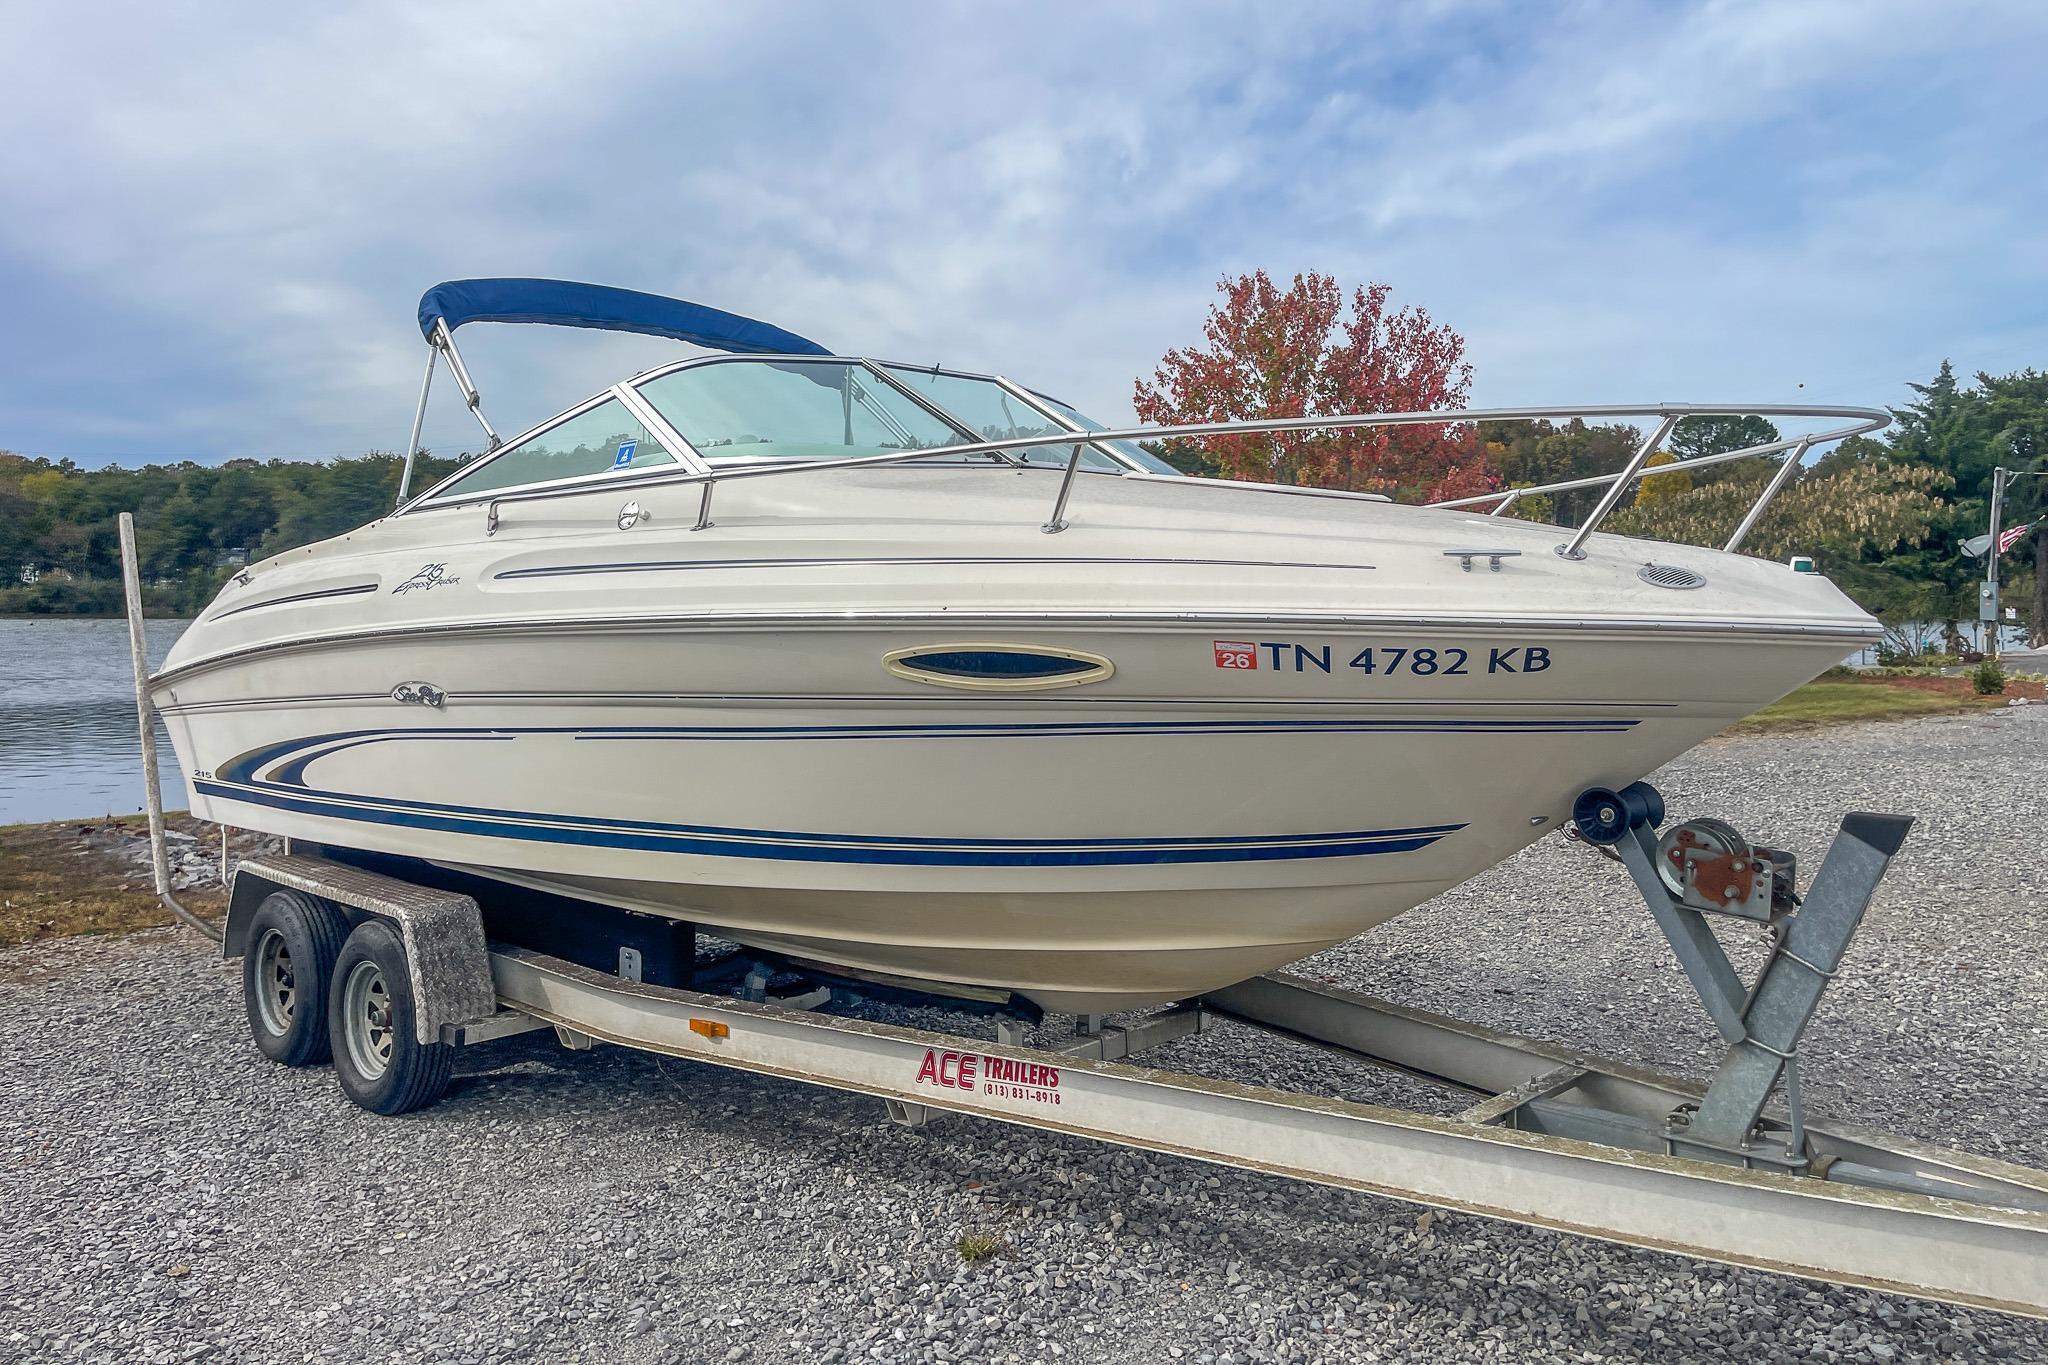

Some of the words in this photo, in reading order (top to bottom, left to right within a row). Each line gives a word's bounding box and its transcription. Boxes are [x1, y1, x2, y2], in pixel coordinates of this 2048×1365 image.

[1222, 652, 1250, 669] 26
[1260, 642, 1331, 674] TN
[1349, 647, 1469, 676] 4782
[1488, 646, 1552, 674] KB
[194, 769, 212, 779] 215
[916, 1048, 979, 1092] ACE
[983, 1056, 1060, 1088] TRAILERS
[983, 1083, 1009, 1099] (813)
[1012, 1087, 1061, 1105] 831-8918
